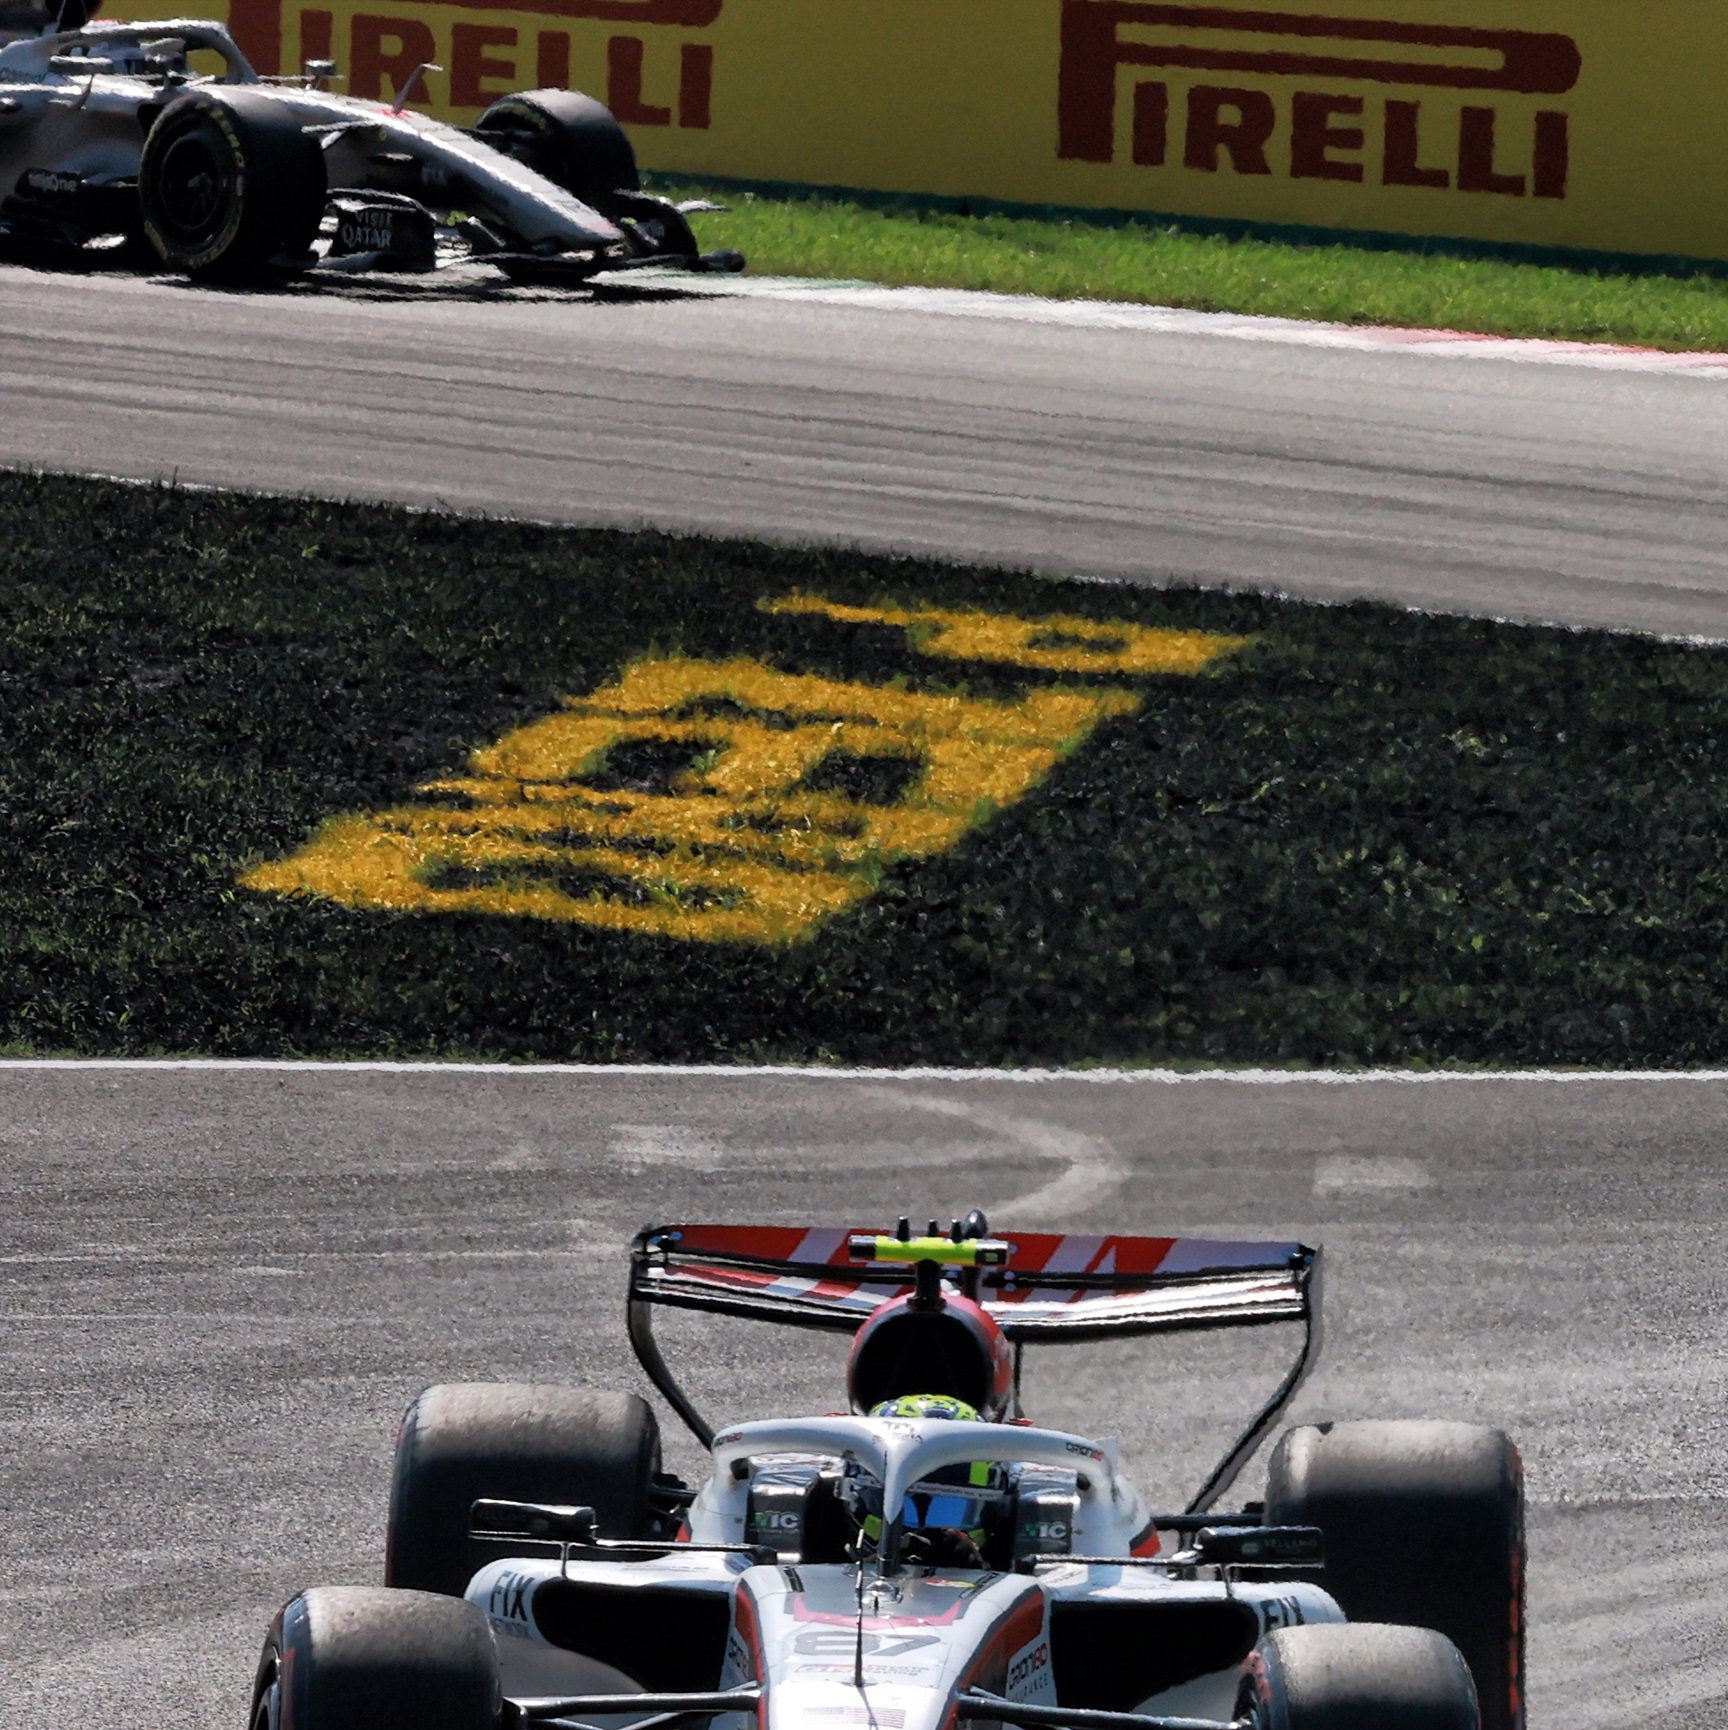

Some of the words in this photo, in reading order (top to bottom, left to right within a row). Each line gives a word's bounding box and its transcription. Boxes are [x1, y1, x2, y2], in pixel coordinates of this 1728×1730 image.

[228, 0, 722, 129] IRELLI
[1056, 0, 1581, 199] PIRELLI
[341, 223, 393, 249] QATAR
[489, 1569, 536, 1622] FIX
[793, 1630, 941, 1657] 87
